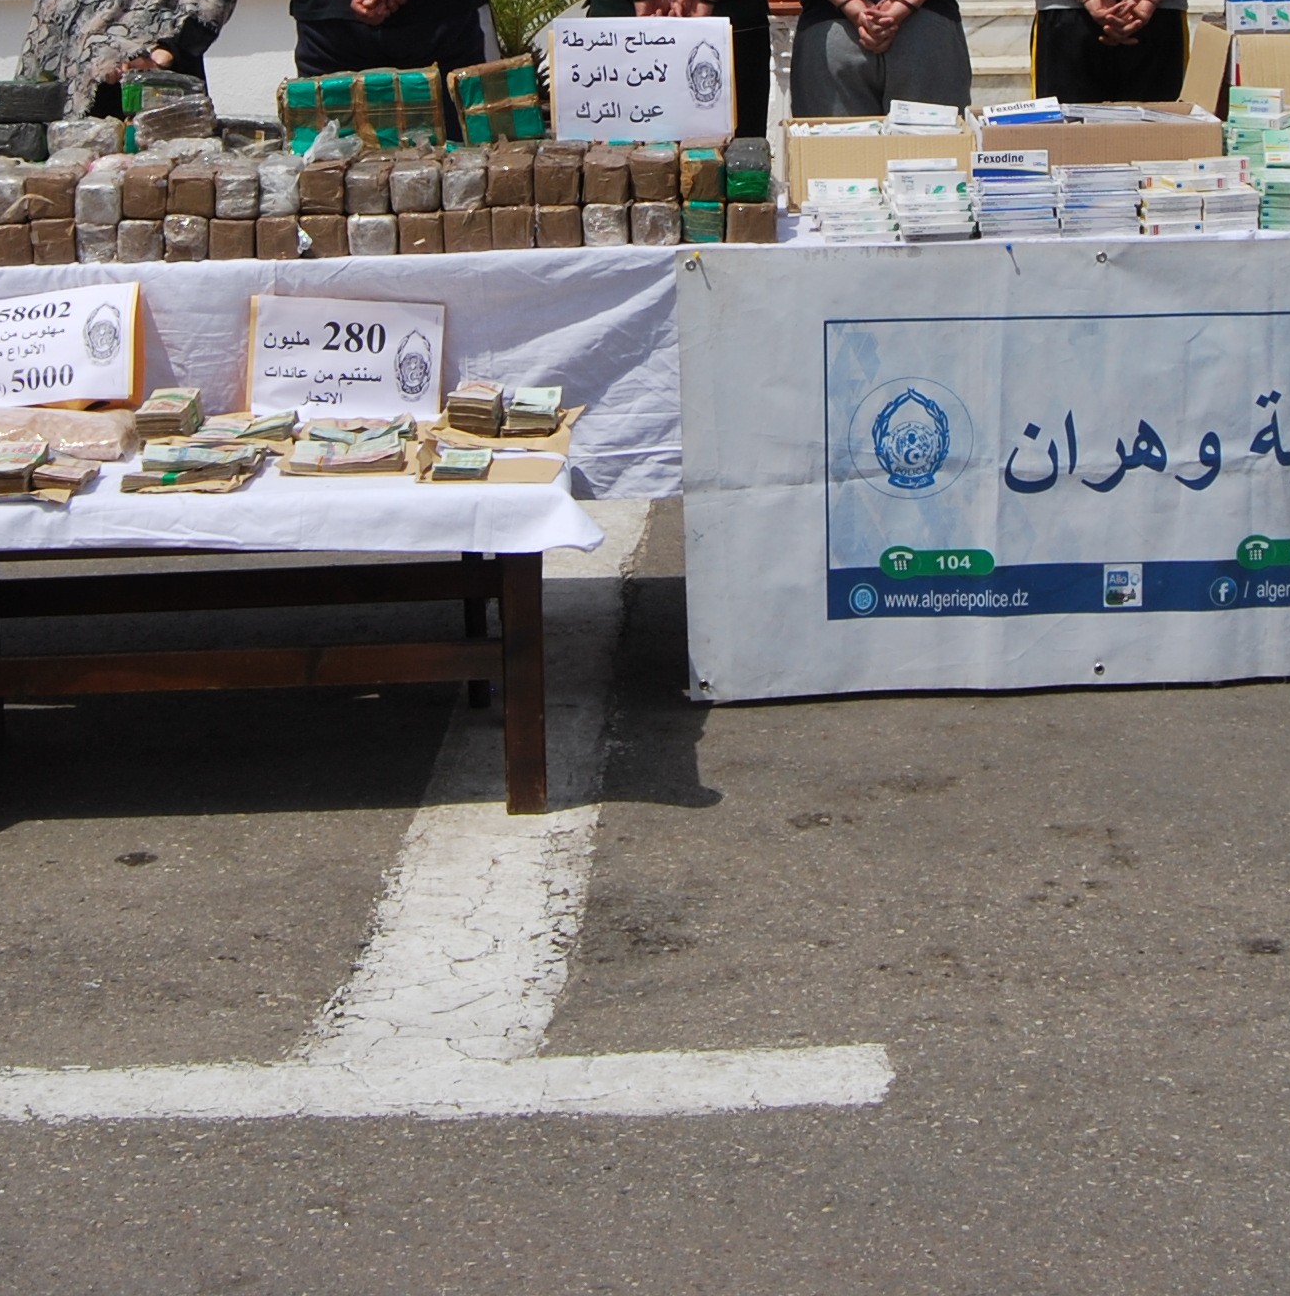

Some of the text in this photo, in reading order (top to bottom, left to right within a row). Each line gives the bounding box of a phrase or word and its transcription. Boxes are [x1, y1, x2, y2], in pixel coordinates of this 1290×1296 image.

[562, 30, 676, 53] مصالح الشرطة
[571, 58, 668, 88] لأمن دائرة
[576, 101, 664, 124] عين الترك
[990, 102, 1036, 113] Fexodine
[977, 153, 1024, 164] Fexodine
[0, 330, 17, 341] من
[21, 326, 65, 340] مهلوس
[263, 321, 386, 354] 280 مليون
[7, 341, 46, 361] الأنواع
[11, 364, 74, 393] 5000
[264, 366, 382, 387] سنتيم من عائدات
[301, 391, 343, 407] الاتجار
[1004, 408, 1221, 495] وهران
[936, 555, 972, 571] 104
[884, 588, 1029, 612] www.algeriepolice.dz
